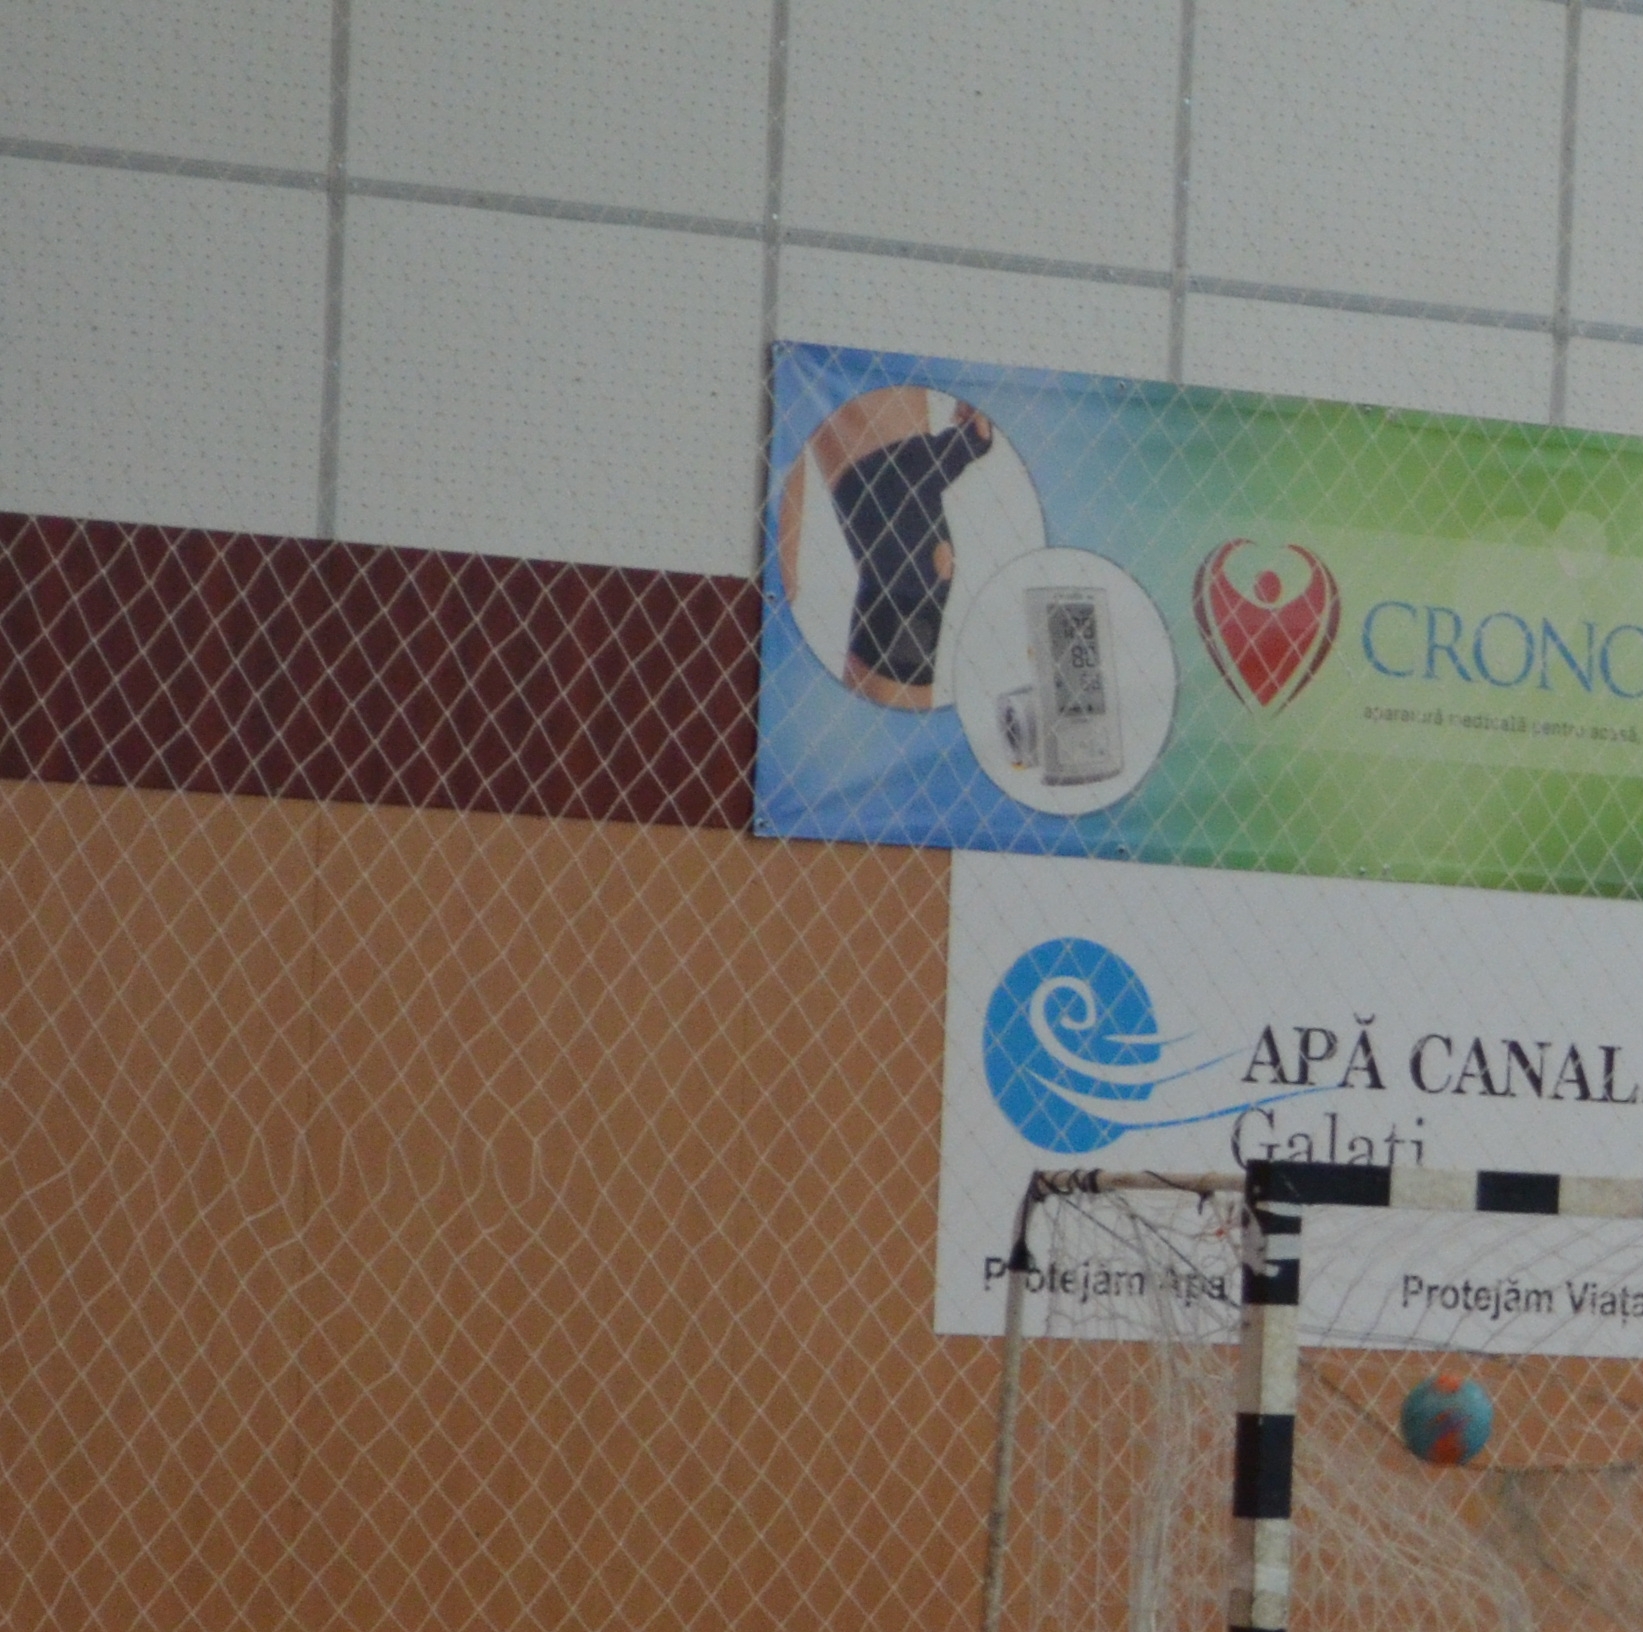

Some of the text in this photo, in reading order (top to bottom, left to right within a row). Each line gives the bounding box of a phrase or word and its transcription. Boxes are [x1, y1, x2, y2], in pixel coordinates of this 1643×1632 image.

[1241, 1012, 1387, 1090] APĂ
[1409, 1033, 1638, 1105] CANAL
[1402, 1274, 1554, 1321] Protejăm
